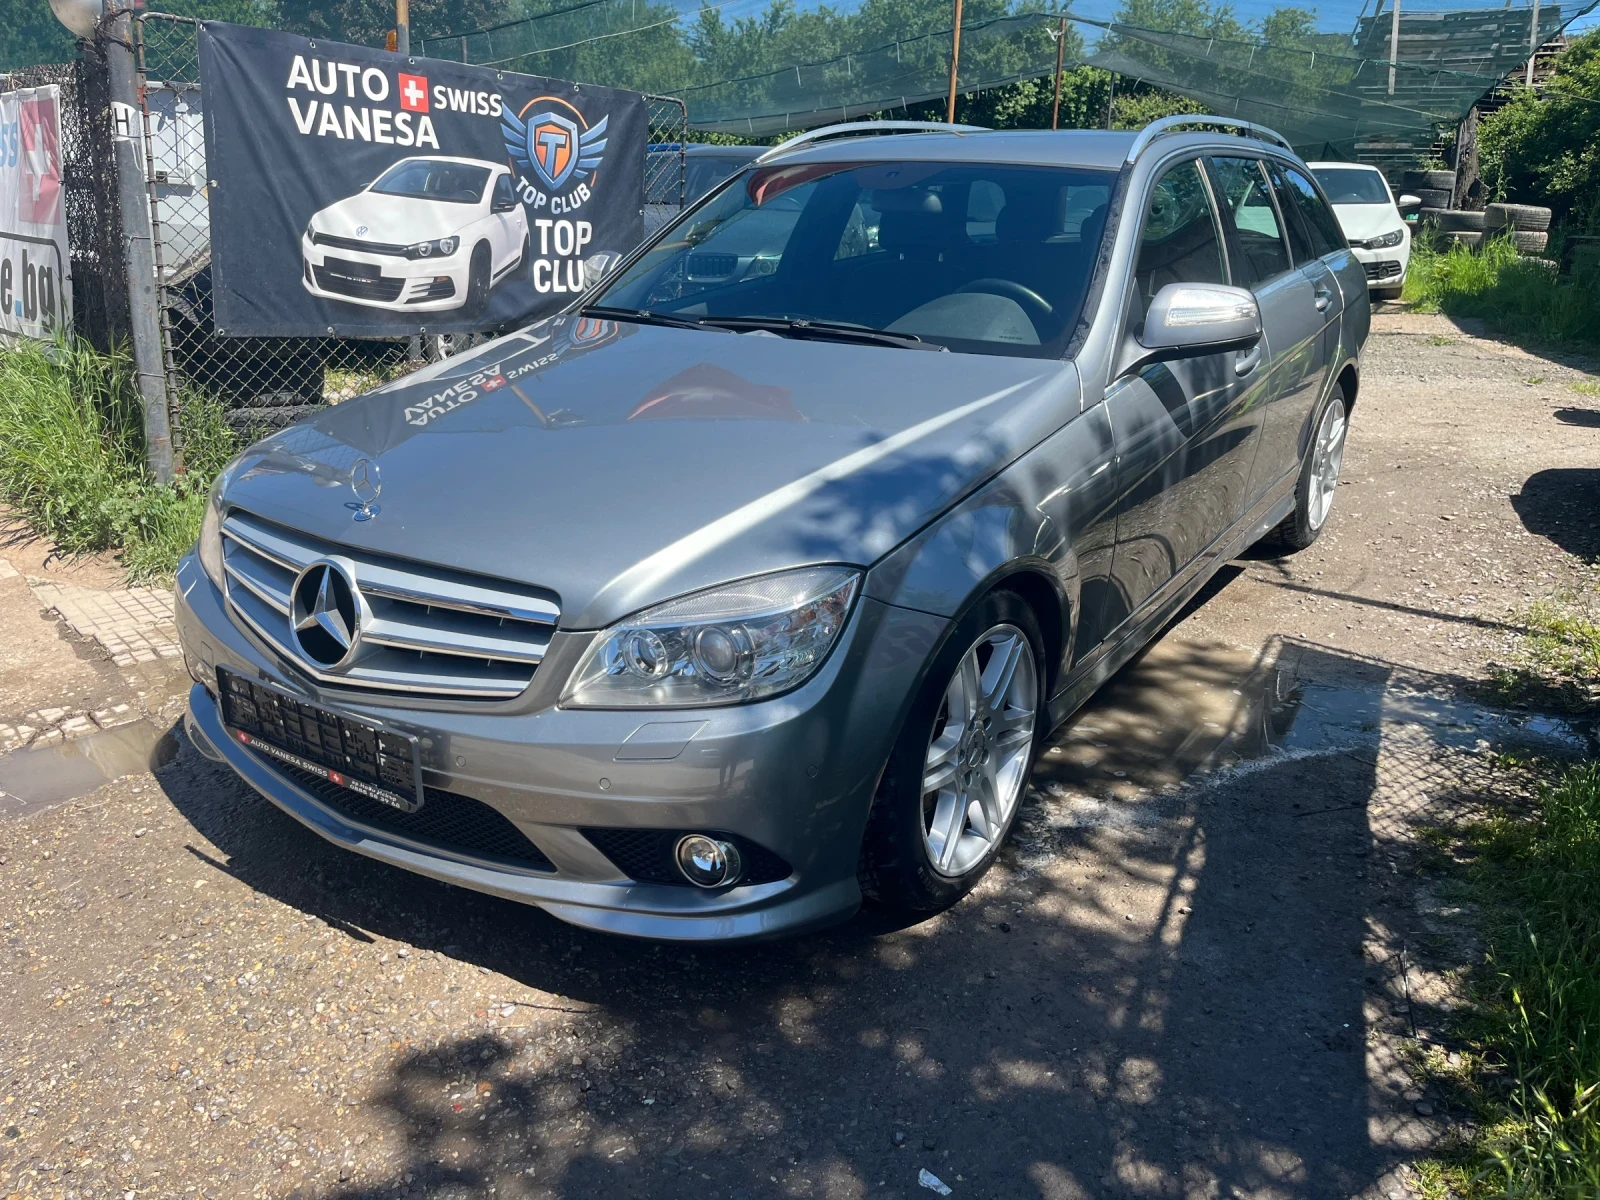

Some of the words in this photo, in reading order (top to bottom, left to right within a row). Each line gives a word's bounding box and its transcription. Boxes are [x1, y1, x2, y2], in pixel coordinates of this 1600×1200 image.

[286, 55, 389, 102] AUTO
[433, 85, 503, 117] SWISS
[114, 108, 129, 135] H
[287, 97, 441, 150] VANESA
[515, 176, 547, 209] TOP
[551, 183, 591, 215] CLUB
[535, 219, 593, 256] TOP
[533, 259, 585, 293] CLU
[250, 739, 269, 751] AUTO
[270, 747, 301, 766] VANESA
[302, 761, 328, 777] SWISS
